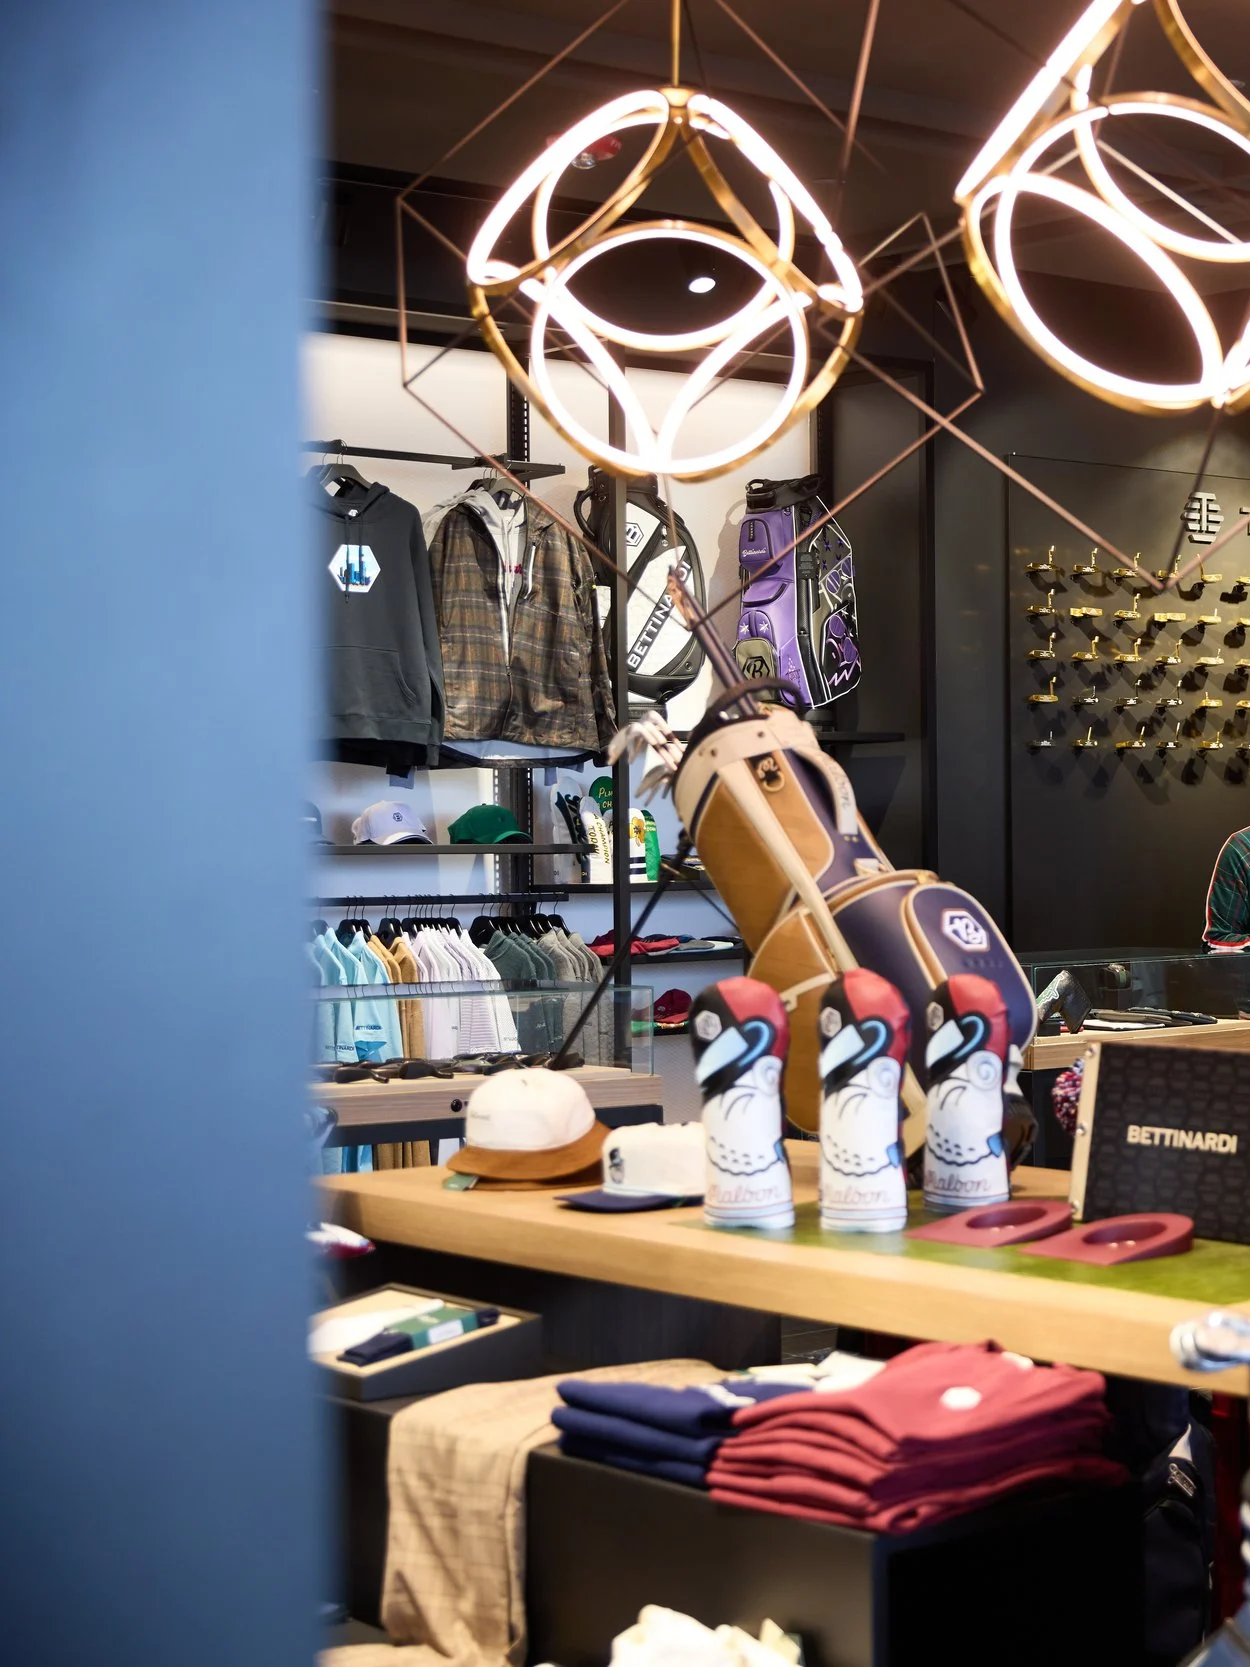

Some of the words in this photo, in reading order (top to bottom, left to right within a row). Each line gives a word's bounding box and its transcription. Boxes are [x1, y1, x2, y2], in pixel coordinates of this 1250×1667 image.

[627, 560, 691, 668] BETTINADI
[596, 822, 610, 865] CHAMPION
[1126, 1124, 1238, 1154] BETTINARDI
